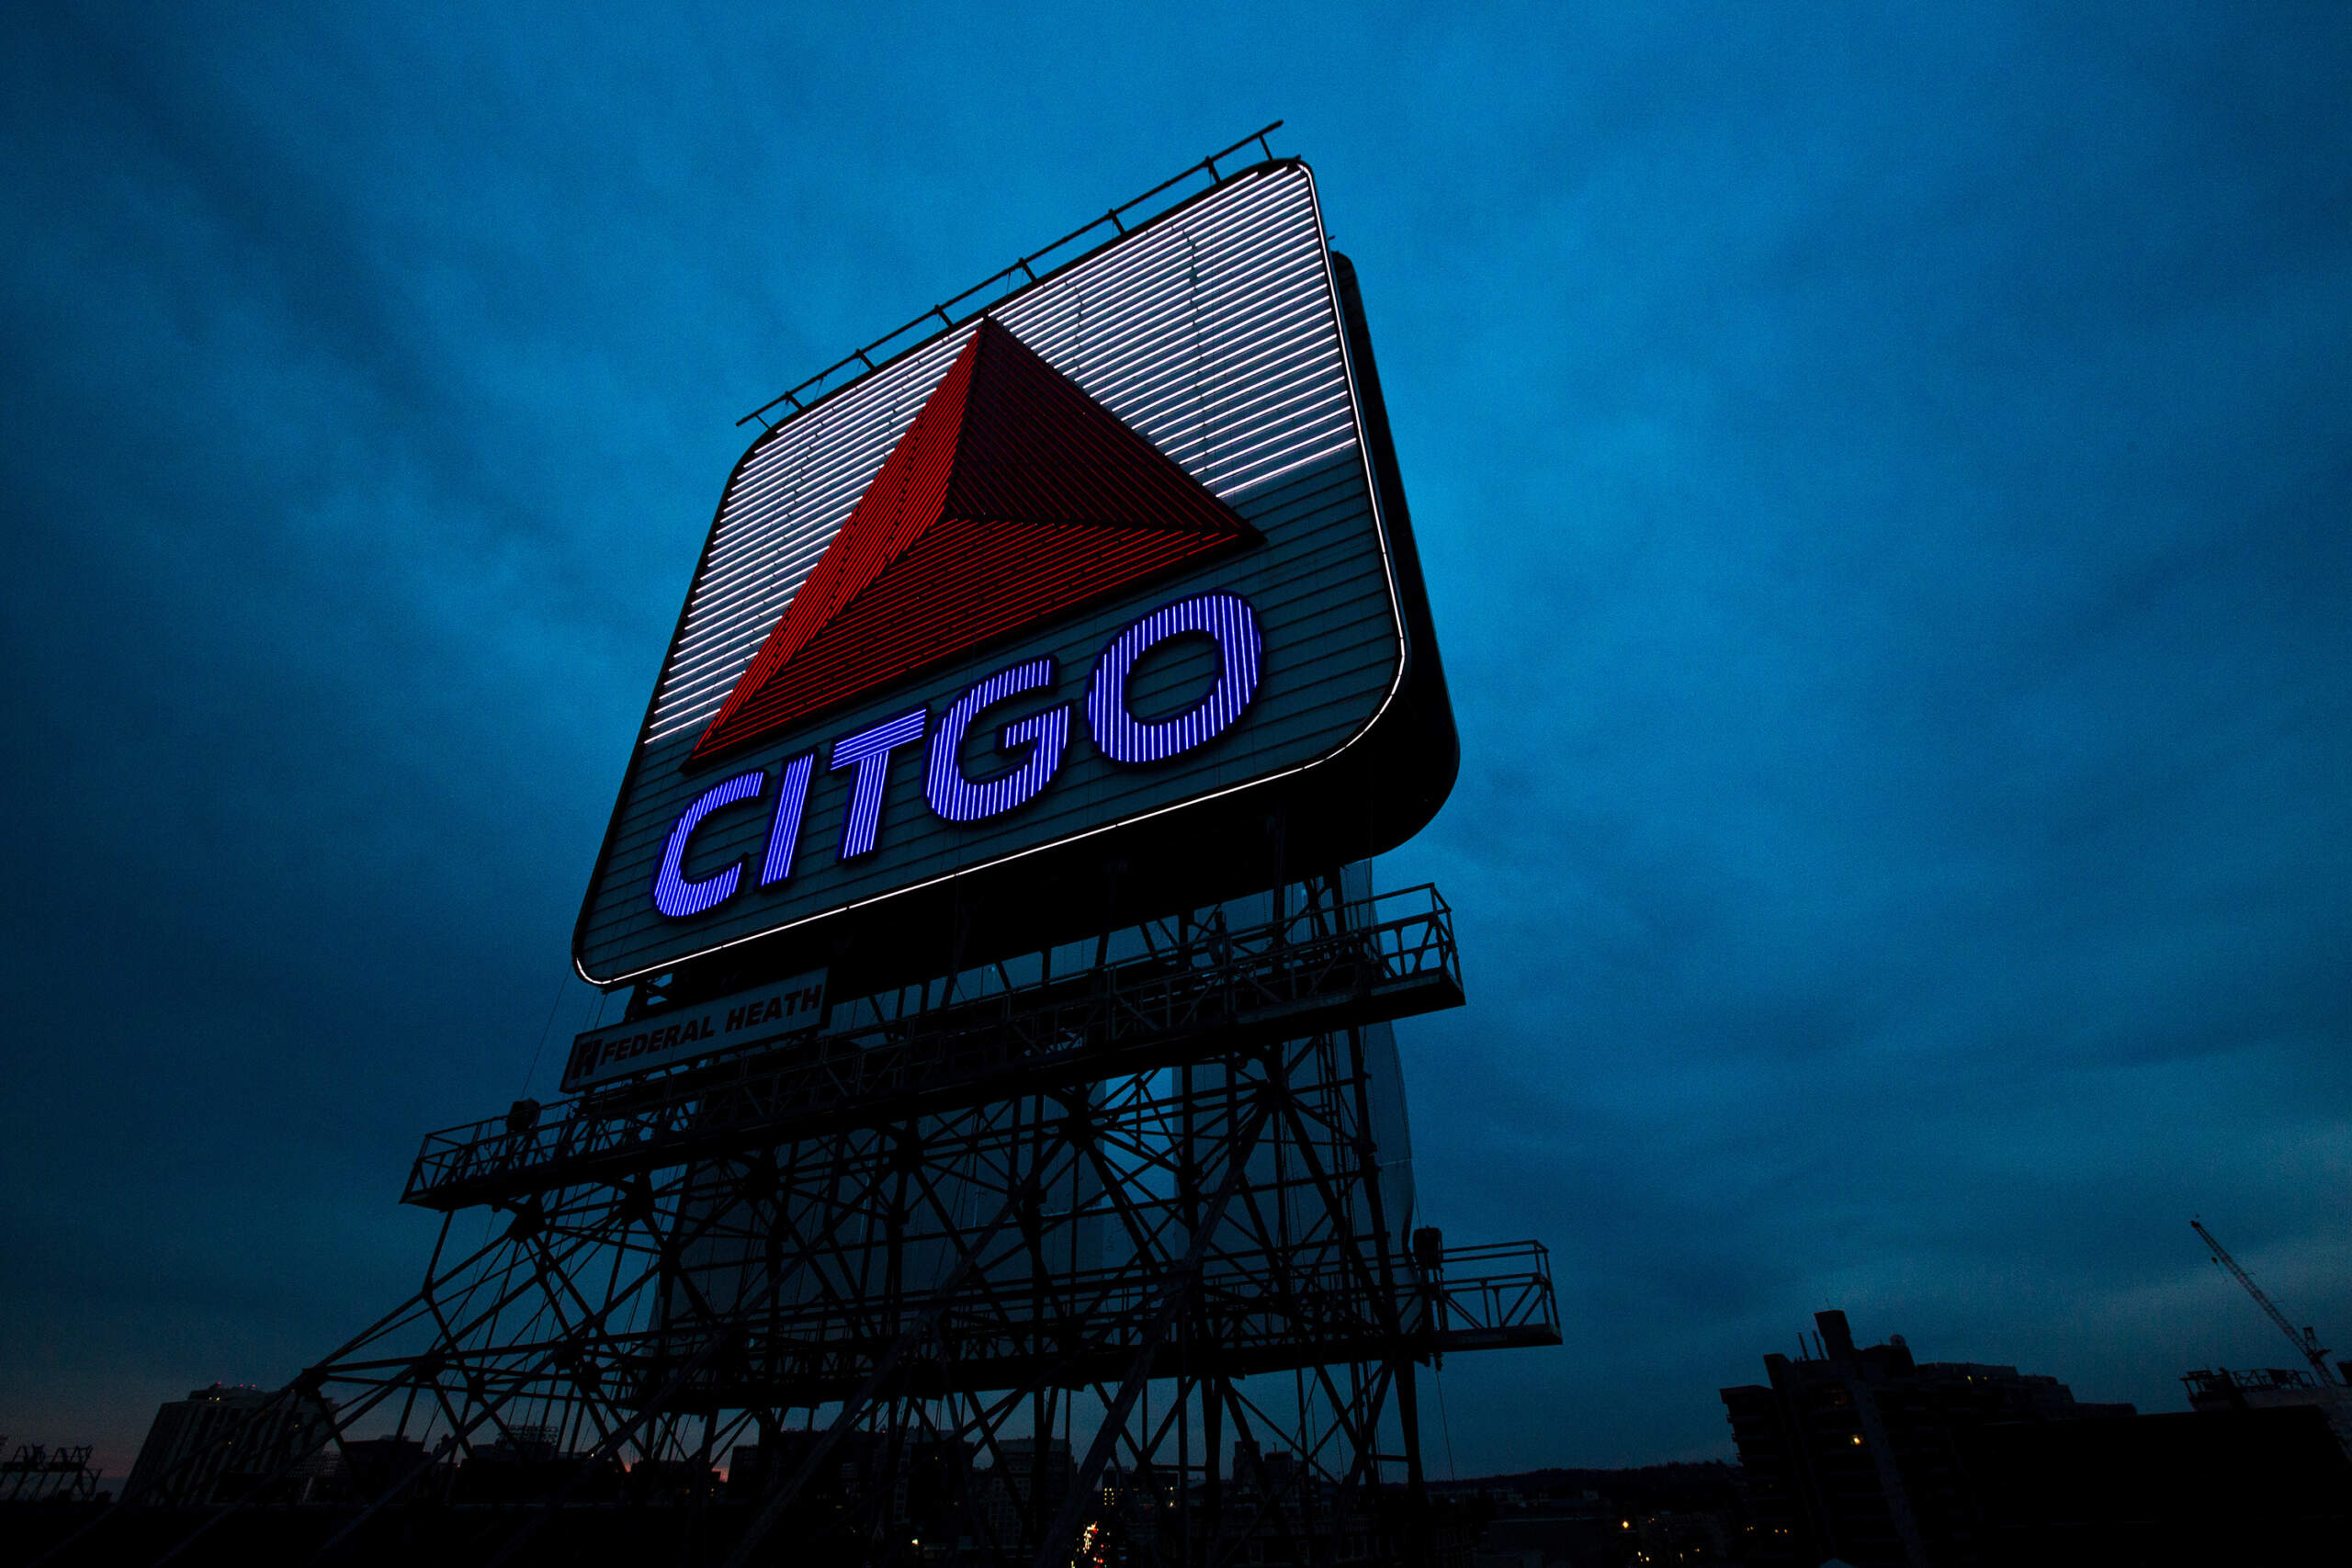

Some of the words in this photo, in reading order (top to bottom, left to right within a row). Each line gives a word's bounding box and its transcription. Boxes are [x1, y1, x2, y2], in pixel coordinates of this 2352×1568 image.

[652, 591, 1264, 919] CITGO
[600, 1017, 714, 1066] FEDERAL
[725, 986, 821, 1031] HEATH
